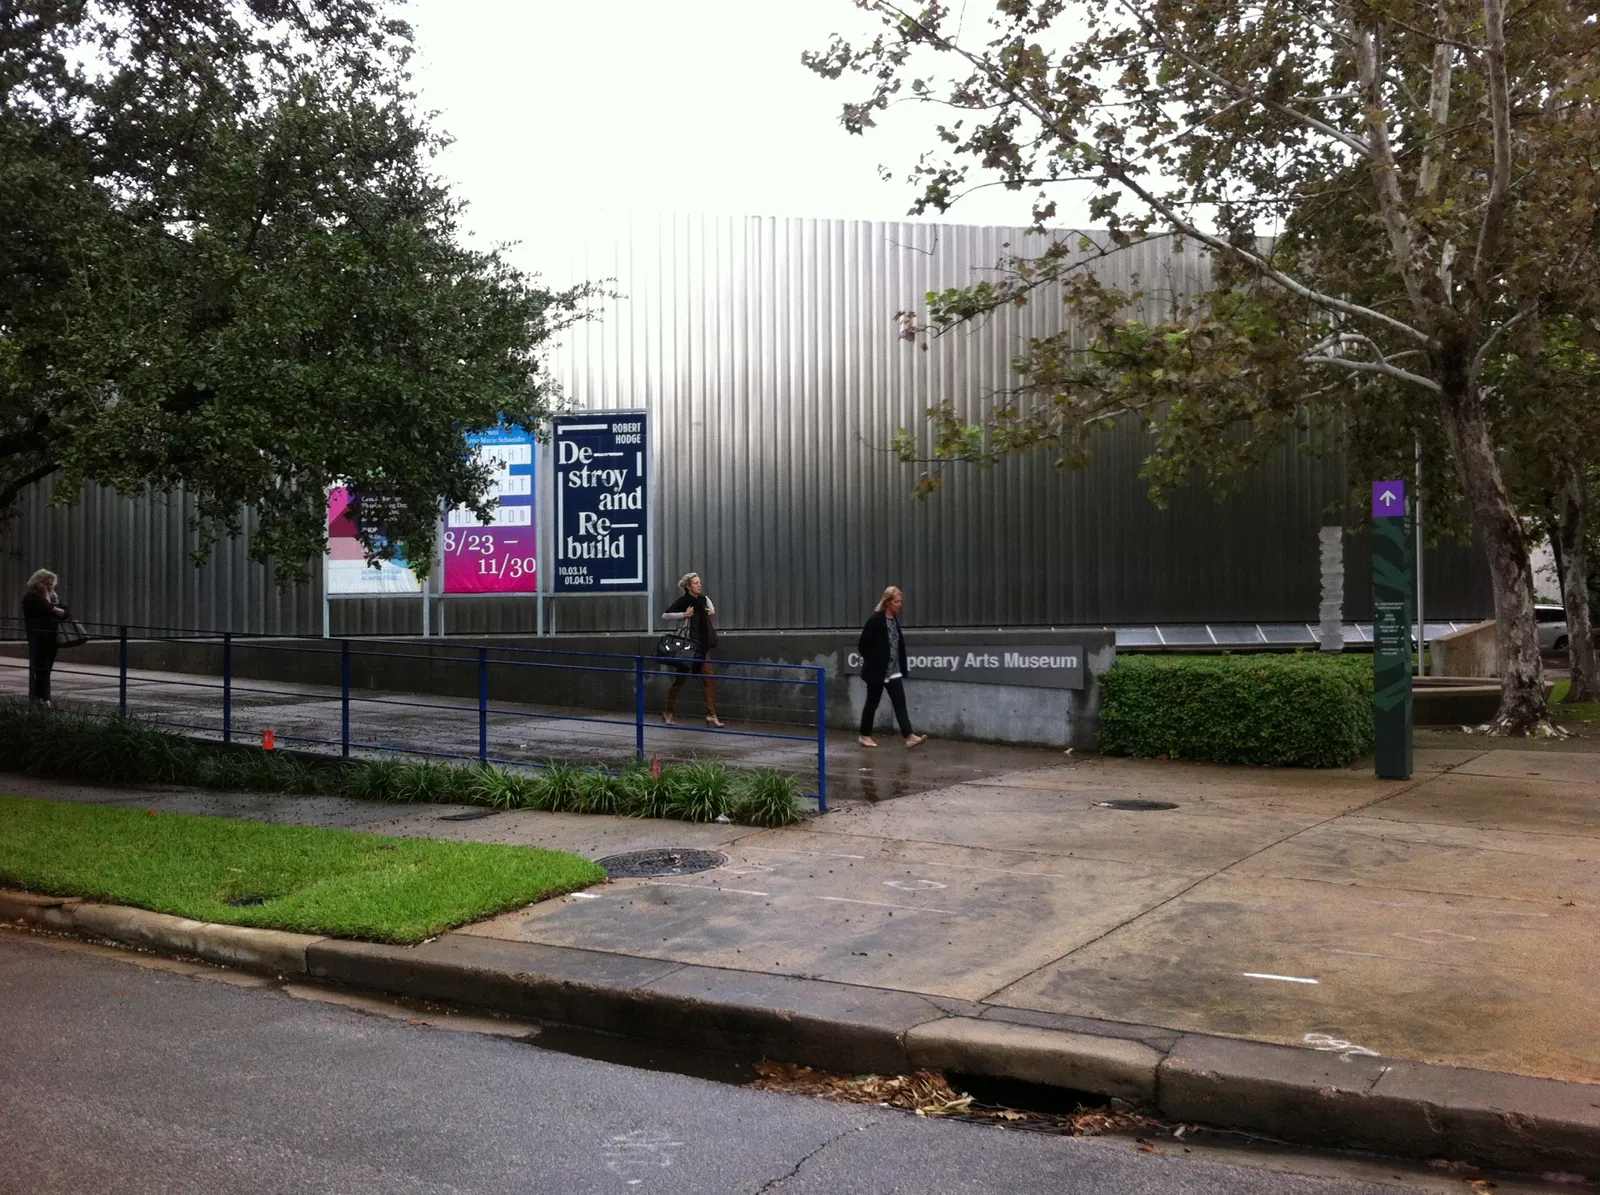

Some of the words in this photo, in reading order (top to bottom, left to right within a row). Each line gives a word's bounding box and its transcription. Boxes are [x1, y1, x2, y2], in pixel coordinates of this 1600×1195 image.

[612, 422, 641, 434] ROBERT
[615, 434, 641, 444] HODGE
[481, 448, 525, 461] IGHT
[568, 464, 628, 493] stroy
[598, 485, 642, 511] and
[453, 509, 525, 524] HOTON
[443, 530, 495, 556] 8/23
[566, 534, 625, 559] build
[478, 553, 536, 579] 11/30
[558, 566, 588, 576] 10.03.14
[564, 575, 594, 585] 01.04.15
[847, 652, 960, 672] Coporary
[963, 652, 1000, 669] Arts
[1003, 652, 1078, 669] Museum
